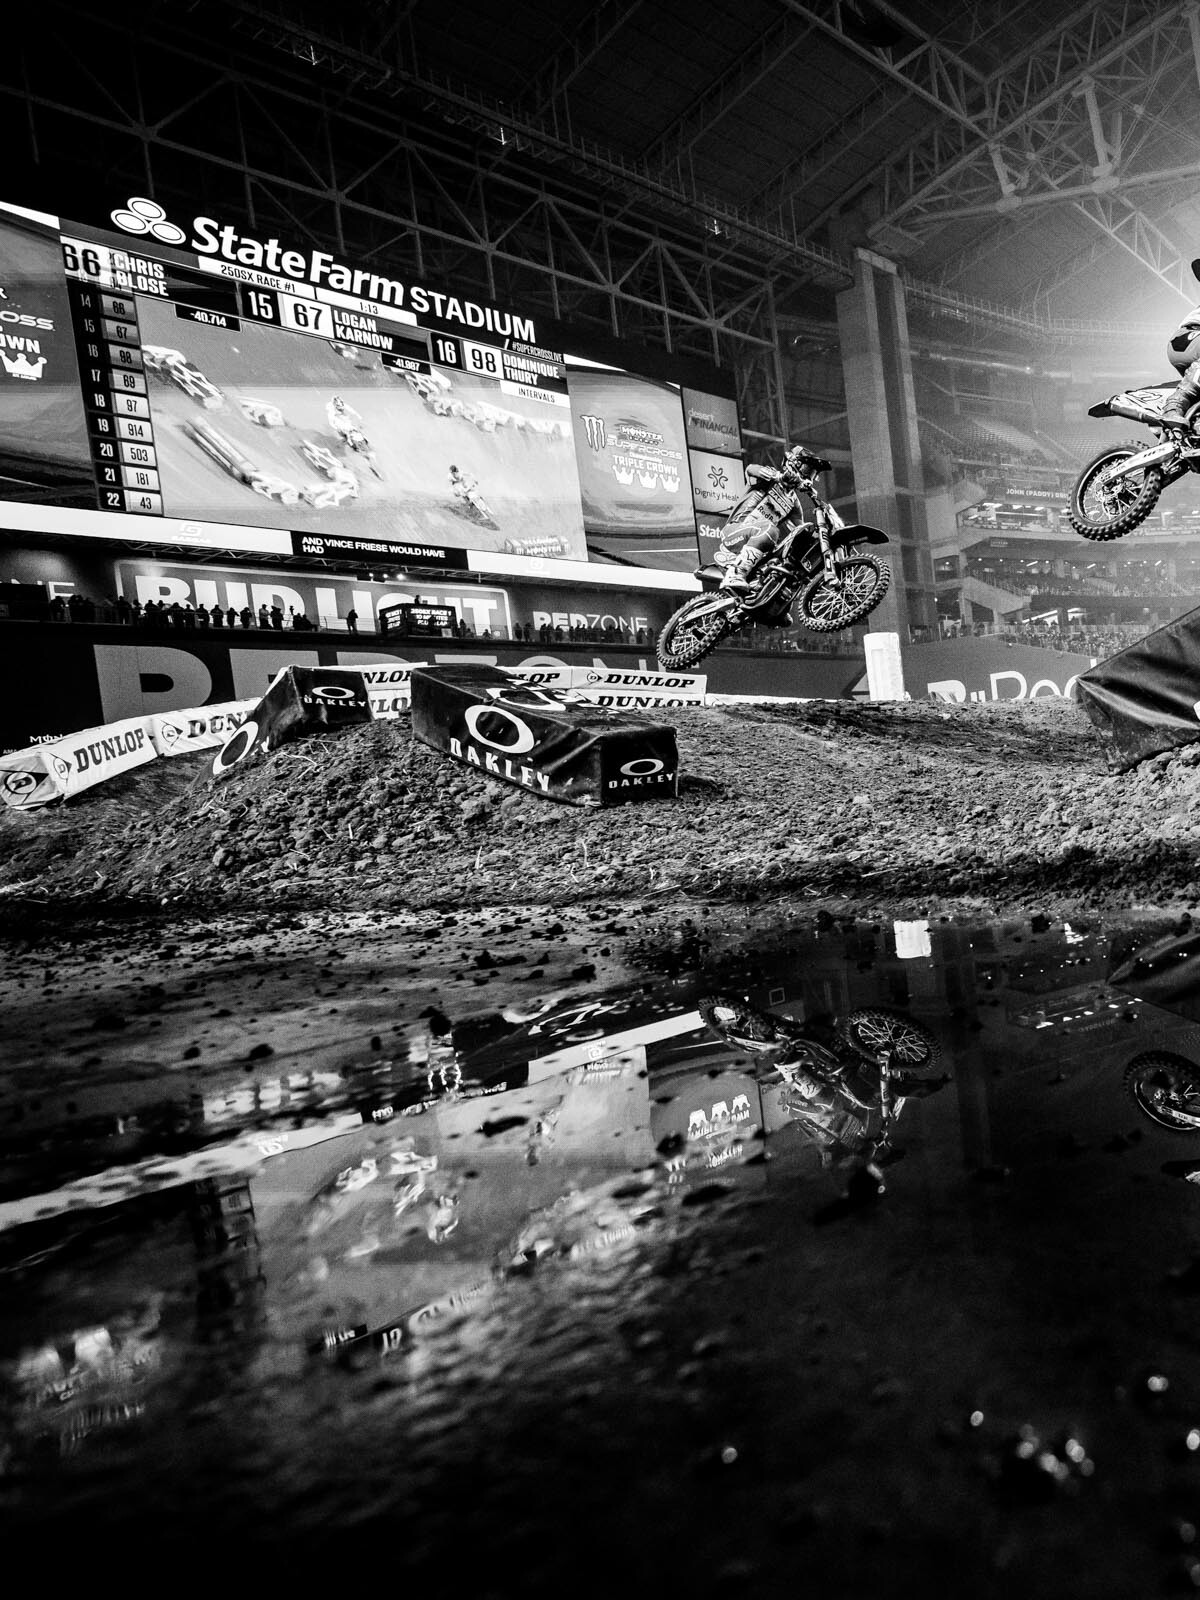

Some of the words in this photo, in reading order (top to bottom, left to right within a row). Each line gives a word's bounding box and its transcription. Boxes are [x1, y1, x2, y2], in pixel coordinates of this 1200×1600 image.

[62, 243, 101, 276] 66
[114, 253, 164, 279] CHRIS
[116, 271, 169, 296] BLOSE
[220, 264, 253, 285] 250SX
[257, 274, 282, 290] RACE
[284, 281, 296, 293] #1
[248, 291, 274, 320] 15
[293, 302, 324, 331] 67
[360, 302, 379, 314] 1:13
[410, 286, 536, 343] STADIUM
[84, 318, 95, 333] 15
[190, 311, 227, 327] -40.714
[334, 309, 377, 332] LOGAN
[335, 325, 393, 350] KARNOW
[435, 339, 457, 365] 16
[471, 348, 497, 373] 98
[91, 369, 101, 382] 17
[503, 353, 560, 379] DOMINIQUE
[504, 366, 538, 386] THURY
[94, 393, 106, 407] 18
[126, 399, 138, 412] 97
[518, 387, 555, 403] INTERVALS
[97, 418, 109, 432] 19
[128, 423, 144, 437] 914
[621, 426, 665, 442] MONSTER
[100, 443, 114, 457] 20
[130, 447, 148, 462] 503
[612, 454, 645, 470] TRIPLE
[647, 462, 678, 476] CROWN
[104, 468, 116, 482] 21
[136, 472, 150, 486] 181
[106, 492, 120, 507] 22
[140, 496, 152, 510] 43
[695, 487, 721, 500] Dignity
[1006, 488, 1025, 496] JOHN
[302, 536, 323, 546] AND
[324, 539, 354, 550] VINCE
[355, 541, 388, 553] FRIESE
[389, 545, 422, 556] WOULD
[422, 548, 446, 558] HAVE
[302, 545, 324, 554] HAD
[604, 673, 696, 689] DUNLOP
[304, 697, 367, 707] OAKLEY
[73, 727, 146, 774] DUNLOP
[450, 737, 550, 792] OAKLEY
[608, 772, 675, 789] OAKLEY
